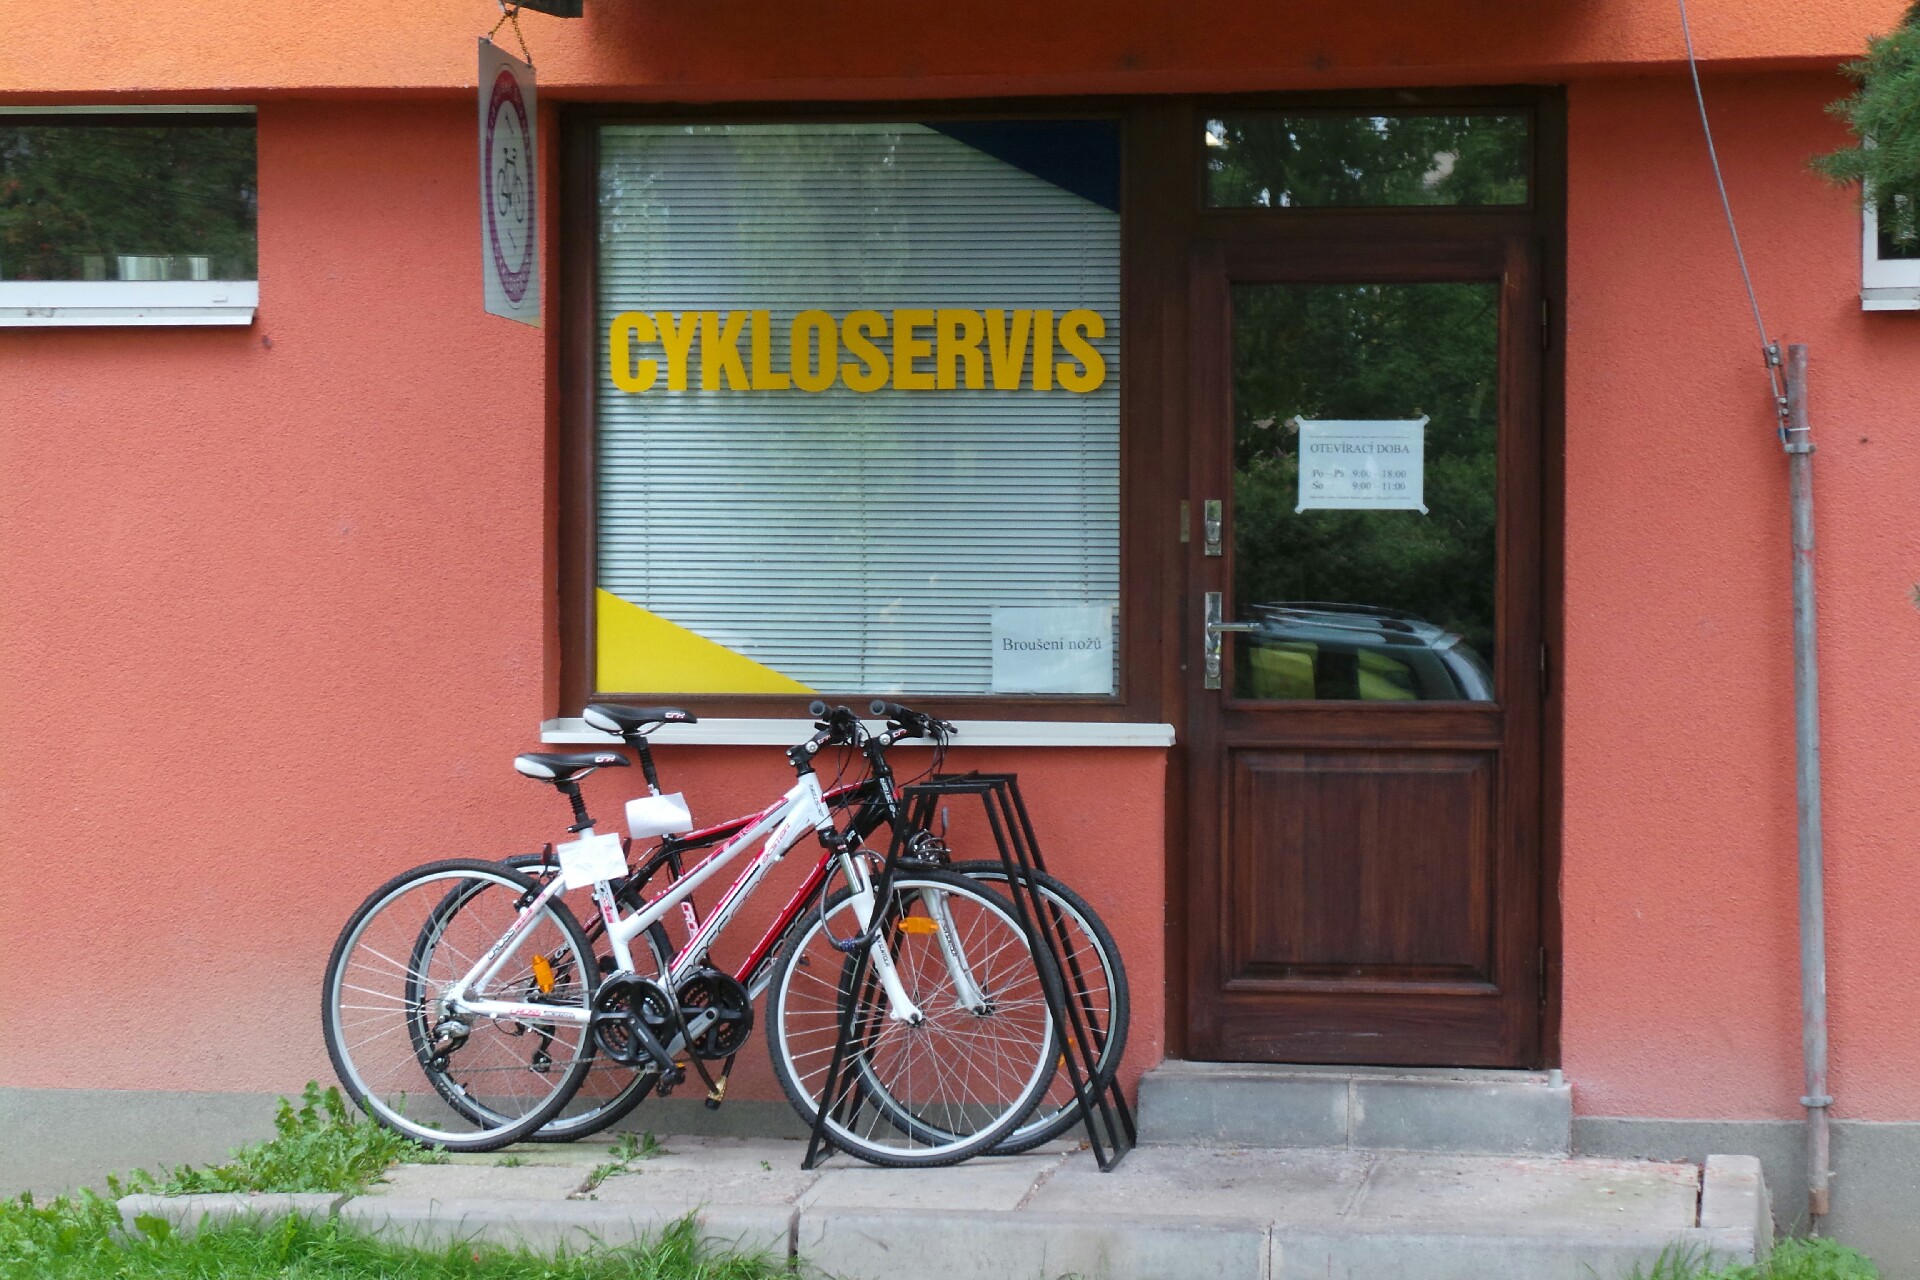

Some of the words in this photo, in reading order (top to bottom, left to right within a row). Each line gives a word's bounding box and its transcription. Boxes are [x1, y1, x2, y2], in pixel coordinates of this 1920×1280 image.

[610, 309, 1106, 393] CYKLOSERVIS
[1377, 444, 1410, 454] DOBA
[1312, 469, 1324, 478] Po
[1382, 469, 1407, 478] 18:00
[1312, 481, 1324, 490] So
[1352, 481, 1371, 490] 9:00
[1382, 481, 1406, 490] 11:00
[1002, 637, 1064, 651] Broušení
